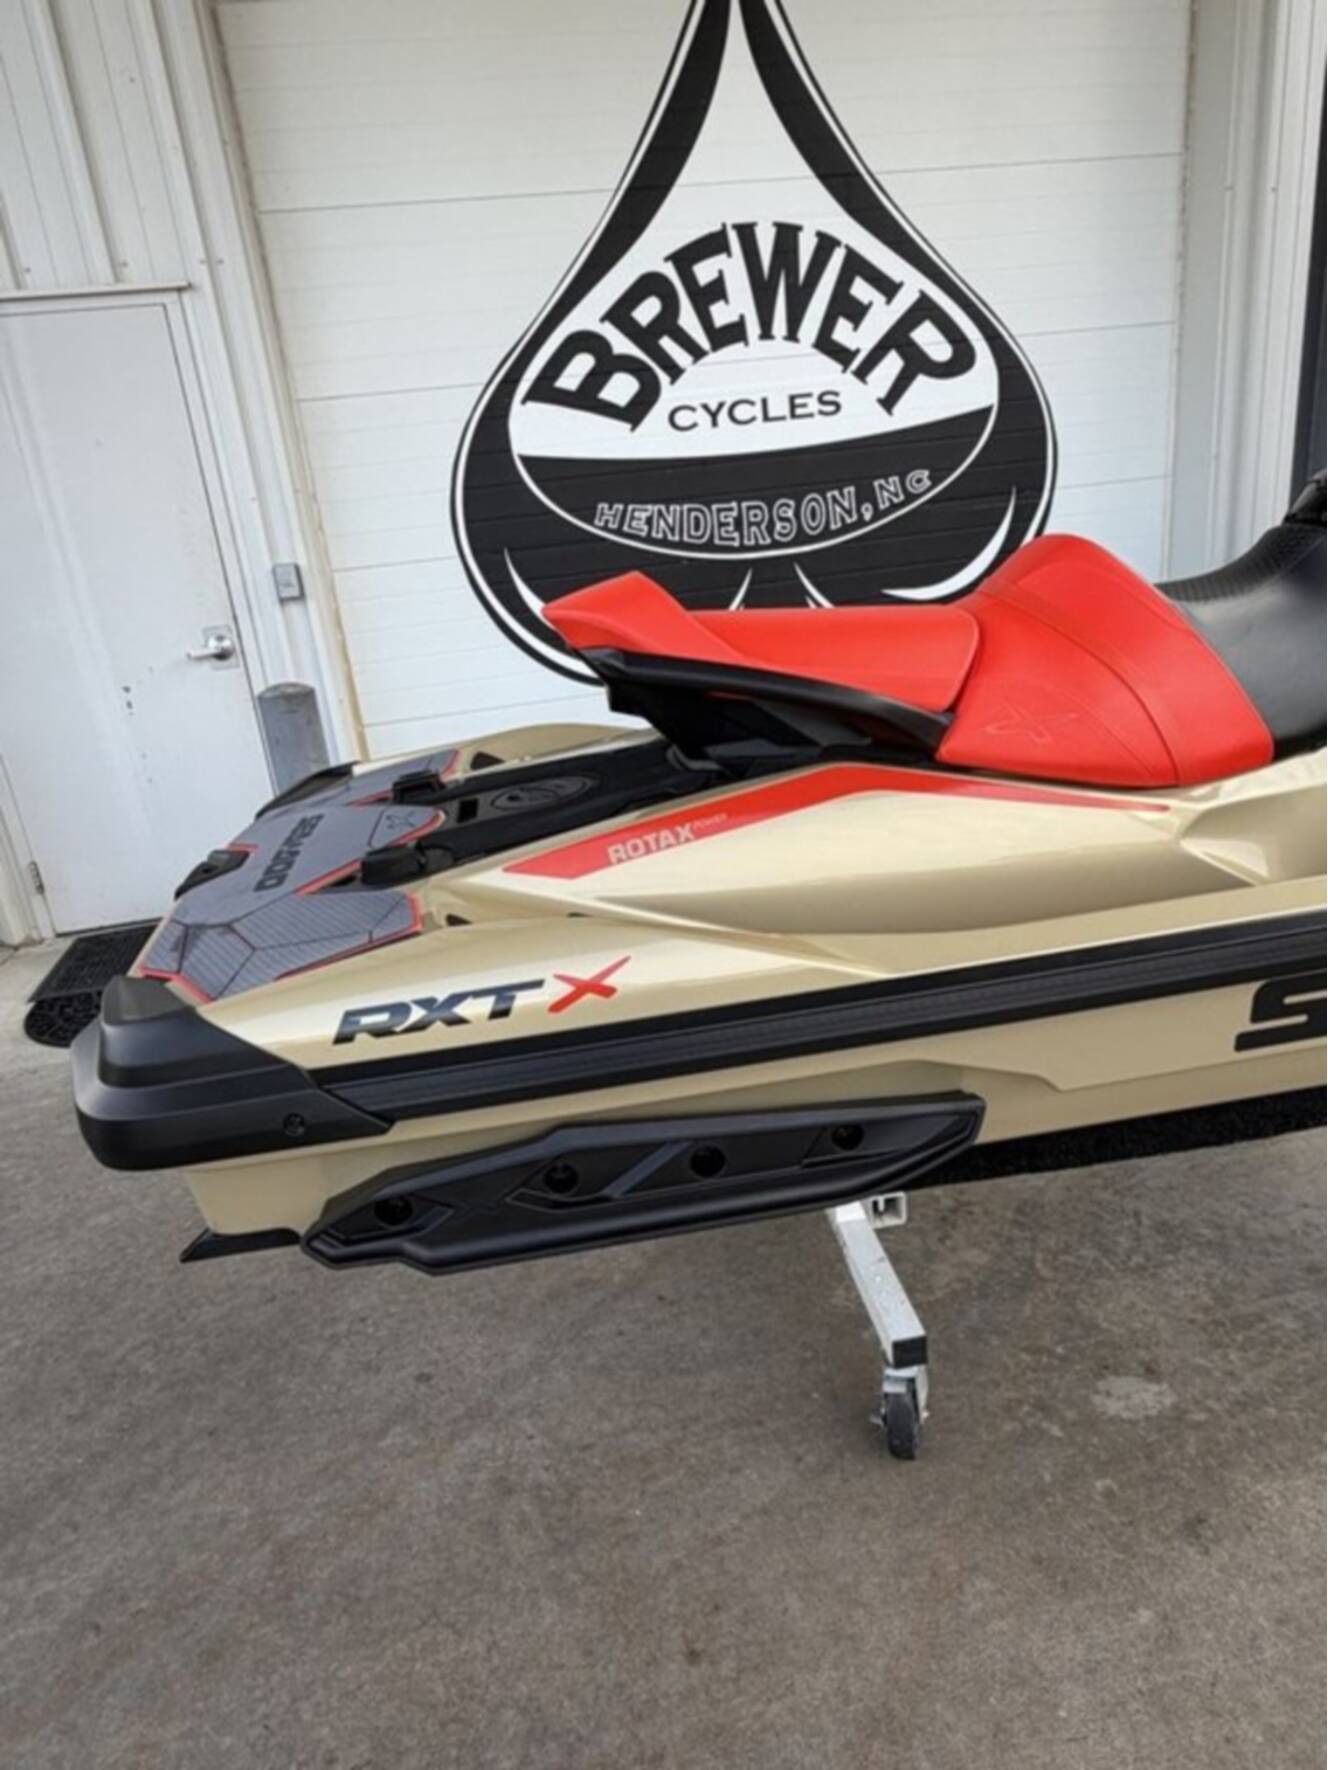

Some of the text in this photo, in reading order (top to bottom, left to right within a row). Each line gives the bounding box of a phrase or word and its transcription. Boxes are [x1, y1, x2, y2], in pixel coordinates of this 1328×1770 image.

[521, 222, 976, 433] BREWER
[667, 389, 843, 432] CYCLES
[607, 820, 696, 866] ROTAX
[332, 978, 546, 1046] RXT
